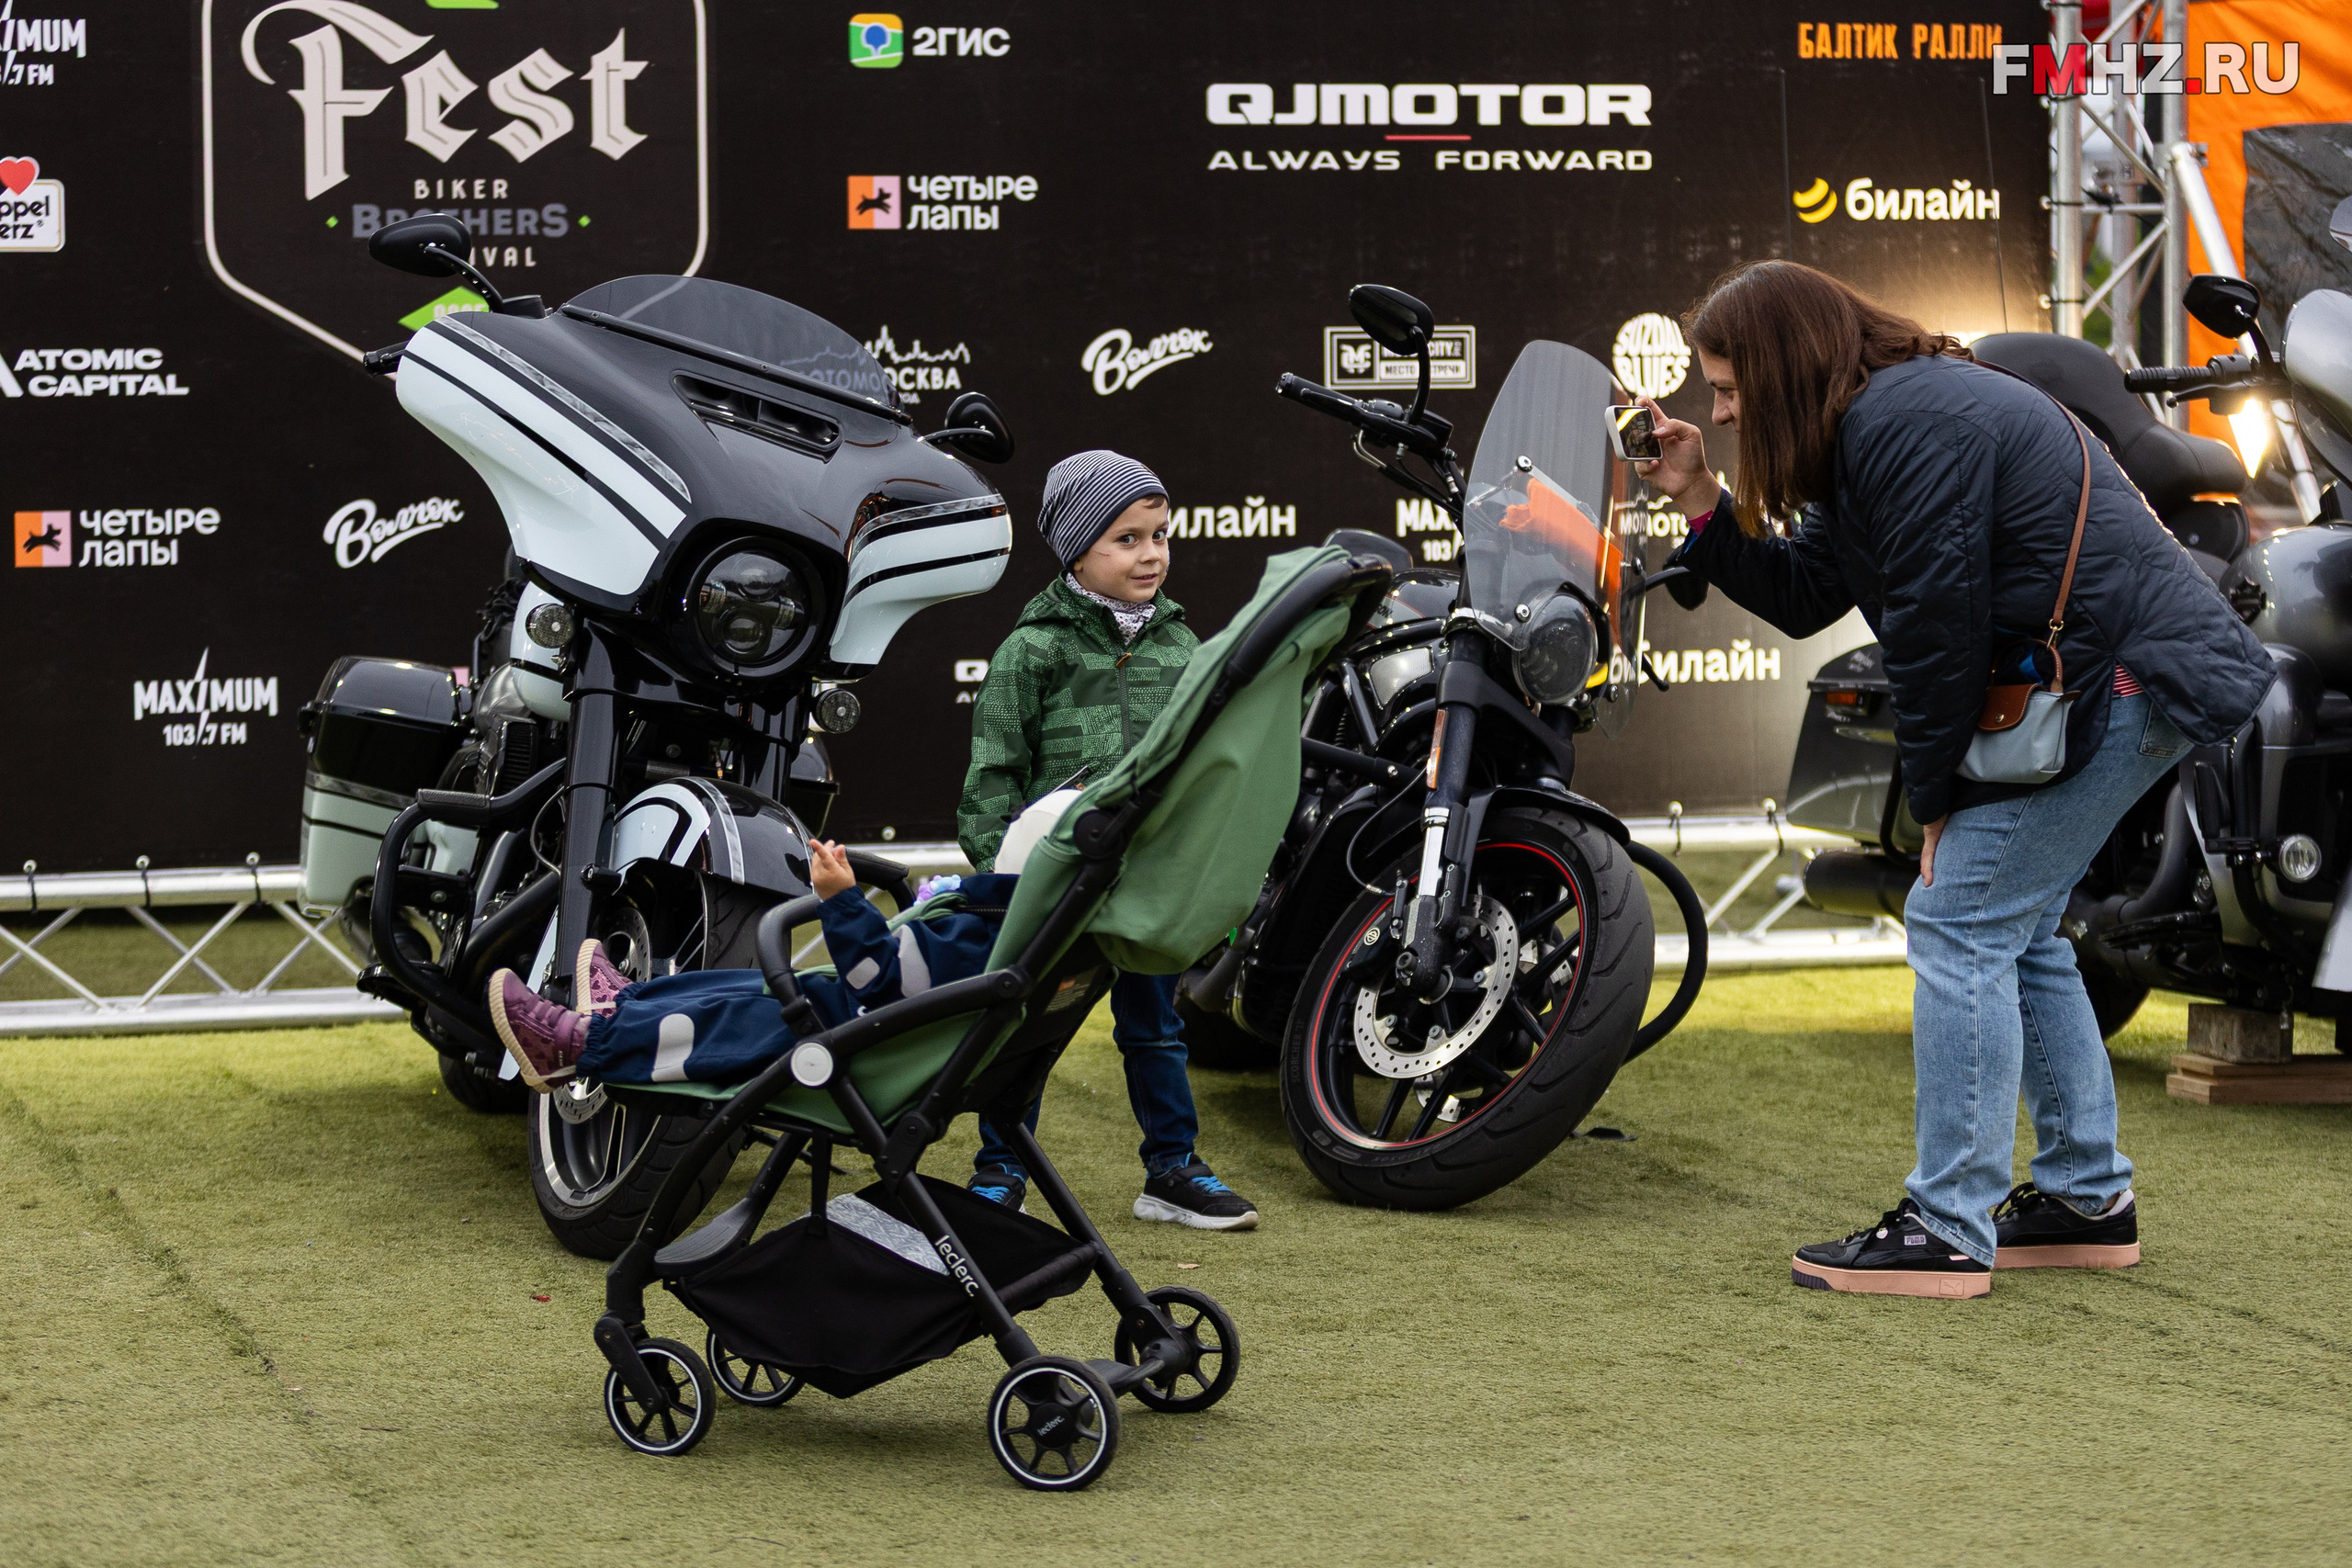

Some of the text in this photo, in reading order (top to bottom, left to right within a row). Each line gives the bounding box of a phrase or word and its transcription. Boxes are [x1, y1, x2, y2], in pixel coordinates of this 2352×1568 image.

[0, 18, 86, 59] IMUM
[911, 26, 1011, 57] 2ГИС
[1798, 23, 2003, 59] БАЛТИК РАЛЛИ
[28, 63, 54, 85] FM
[242, 0, 649, 200] Fest
[1205, 84, 1652, 126] QJMOTOR
[1207, 150, 1653, 171] ALWAYS FORWARD
[413, 178, 509, 199] BIKER
[1845, 178, 2000, 221] билайн
[352, 203, 569, 239] BHERS
[1611, 312, 1691, 356] SUZDAL
[14, 347, 164, 371] ATOMIC
[1612, 355, 1690, 399] BLUES
[28, 373, 190, 397] CAPITAL
[1165, 495, 1296, 539] илайн
[133, 676, 278, 721] MAXIMUM
[220, 721, 247, 745] FM
